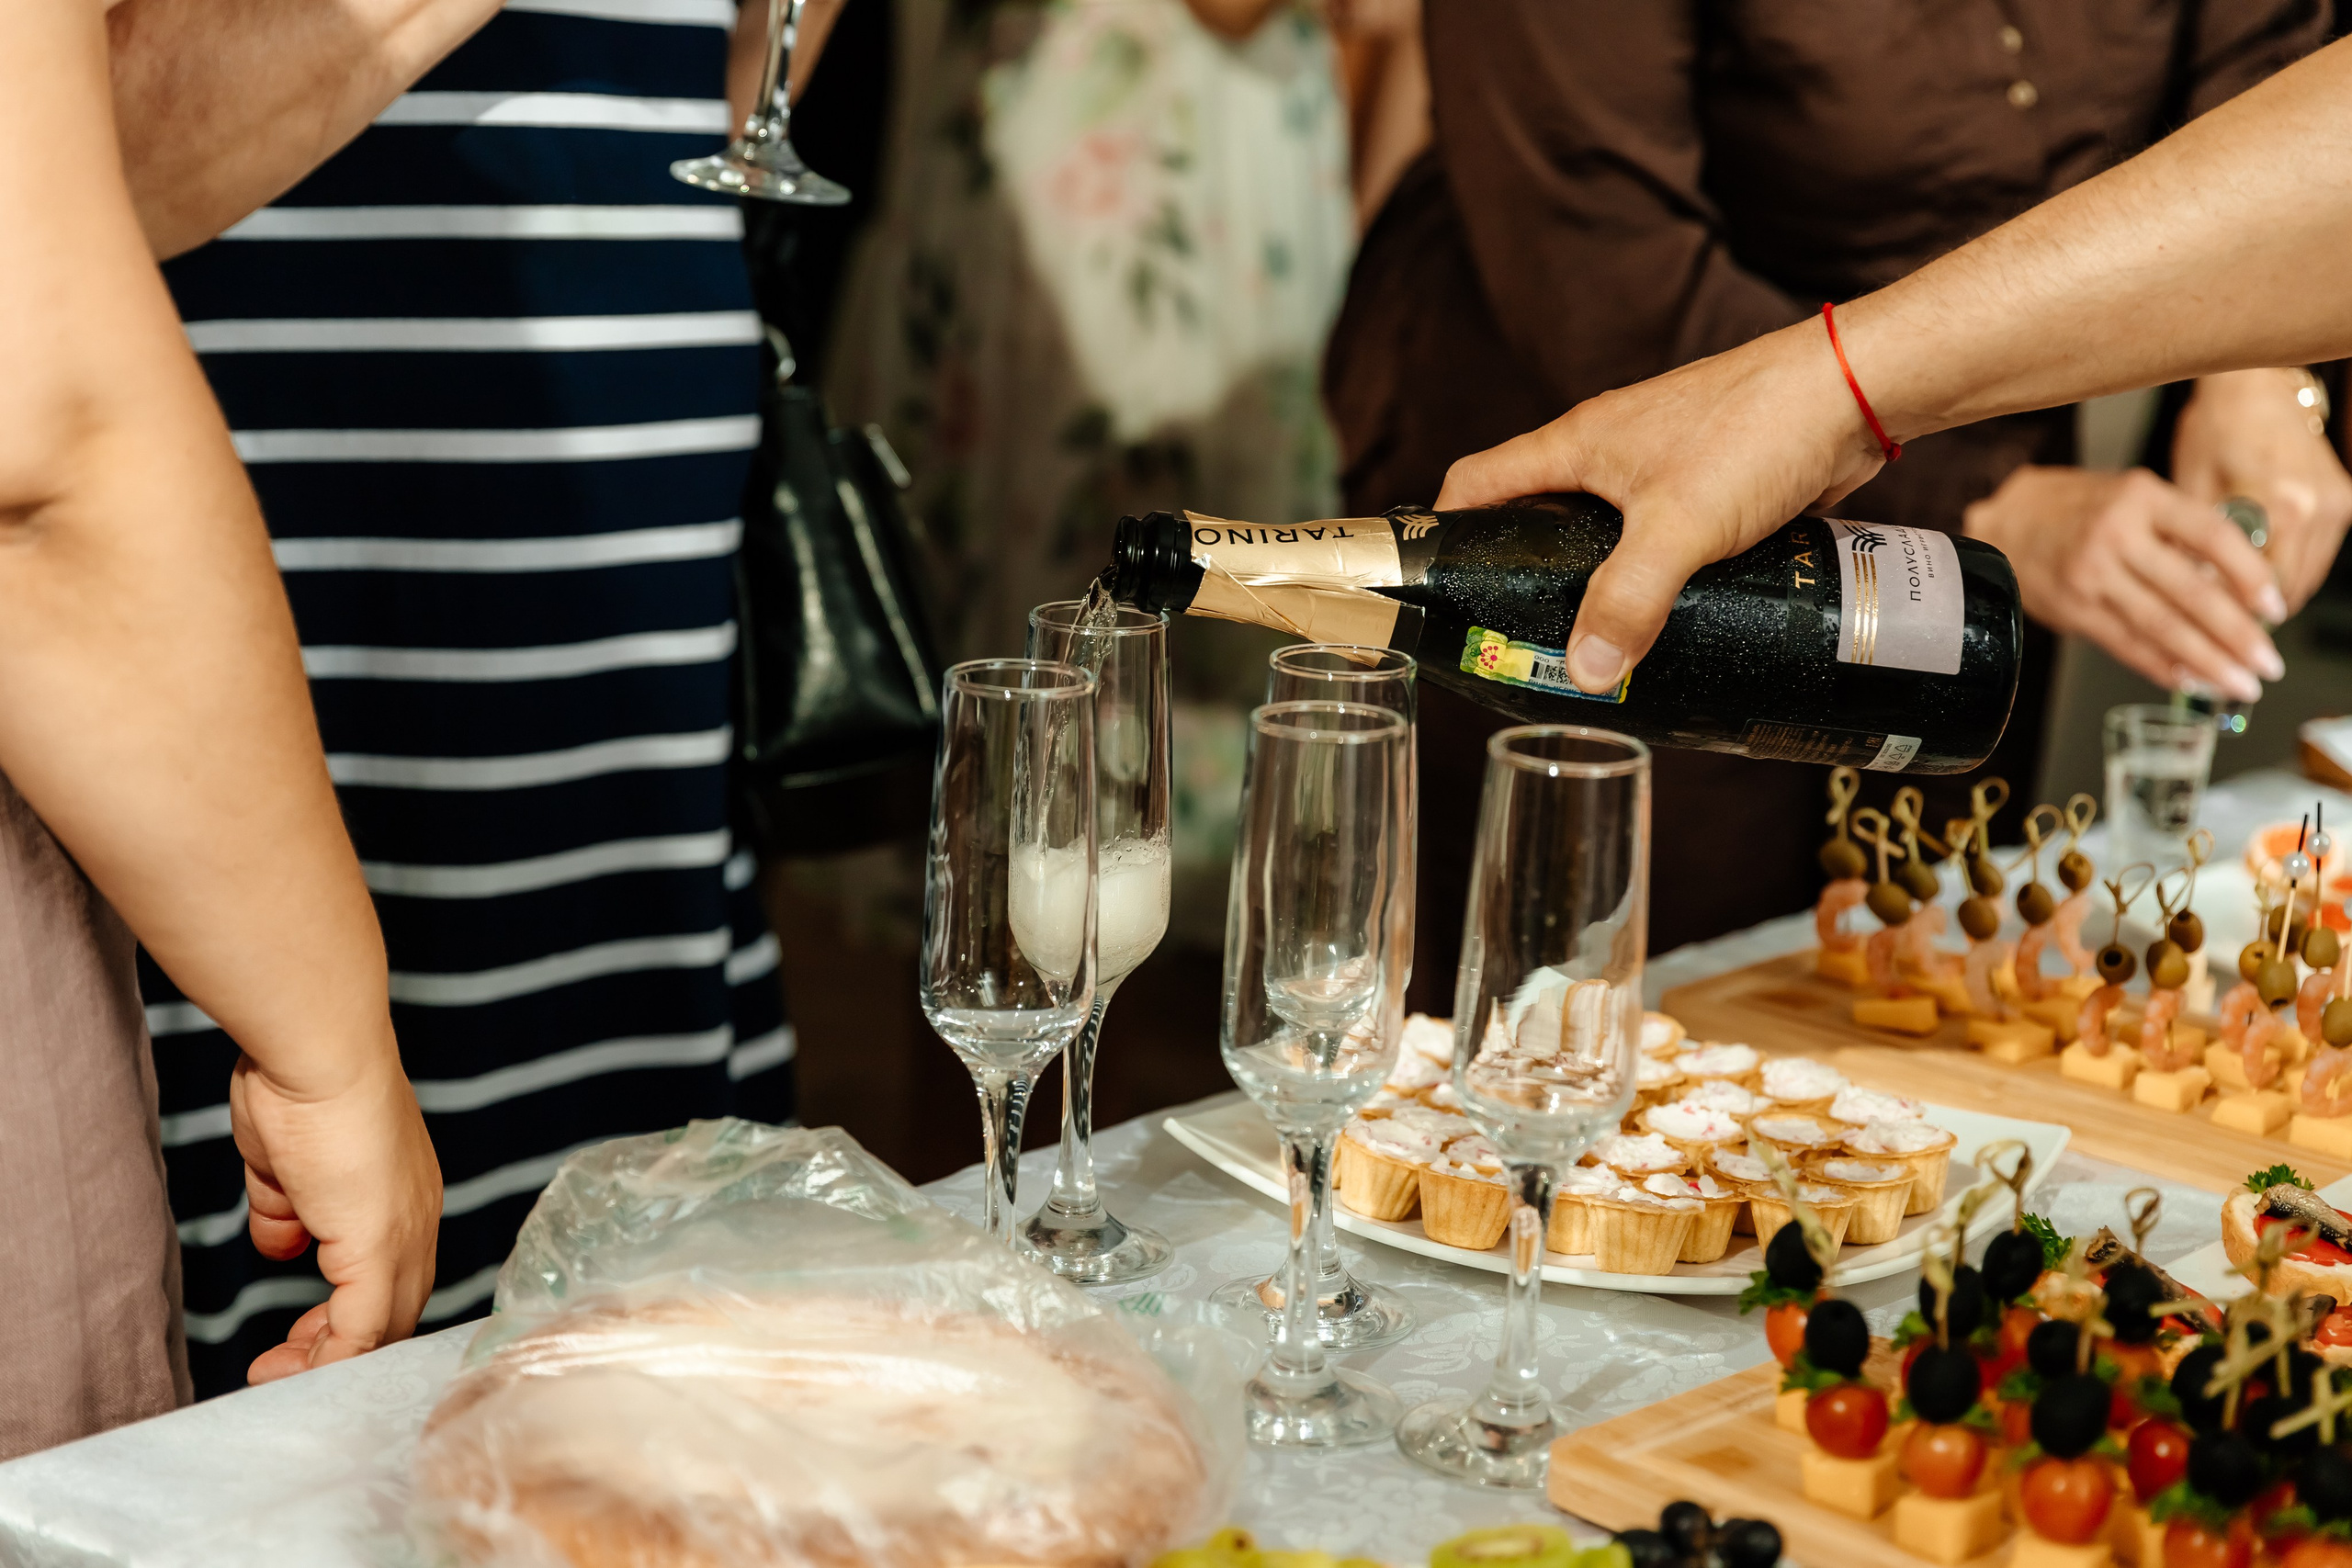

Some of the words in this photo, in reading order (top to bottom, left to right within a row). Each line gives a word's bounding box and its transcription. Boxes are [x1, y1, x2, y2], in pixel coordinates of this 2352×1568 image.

[1194, 526, 1354, 546] TARINO
[1894, 526, 1921, 602] ПОЛУСЛАД
[1925, 554, 1935, 579] ВИНО
